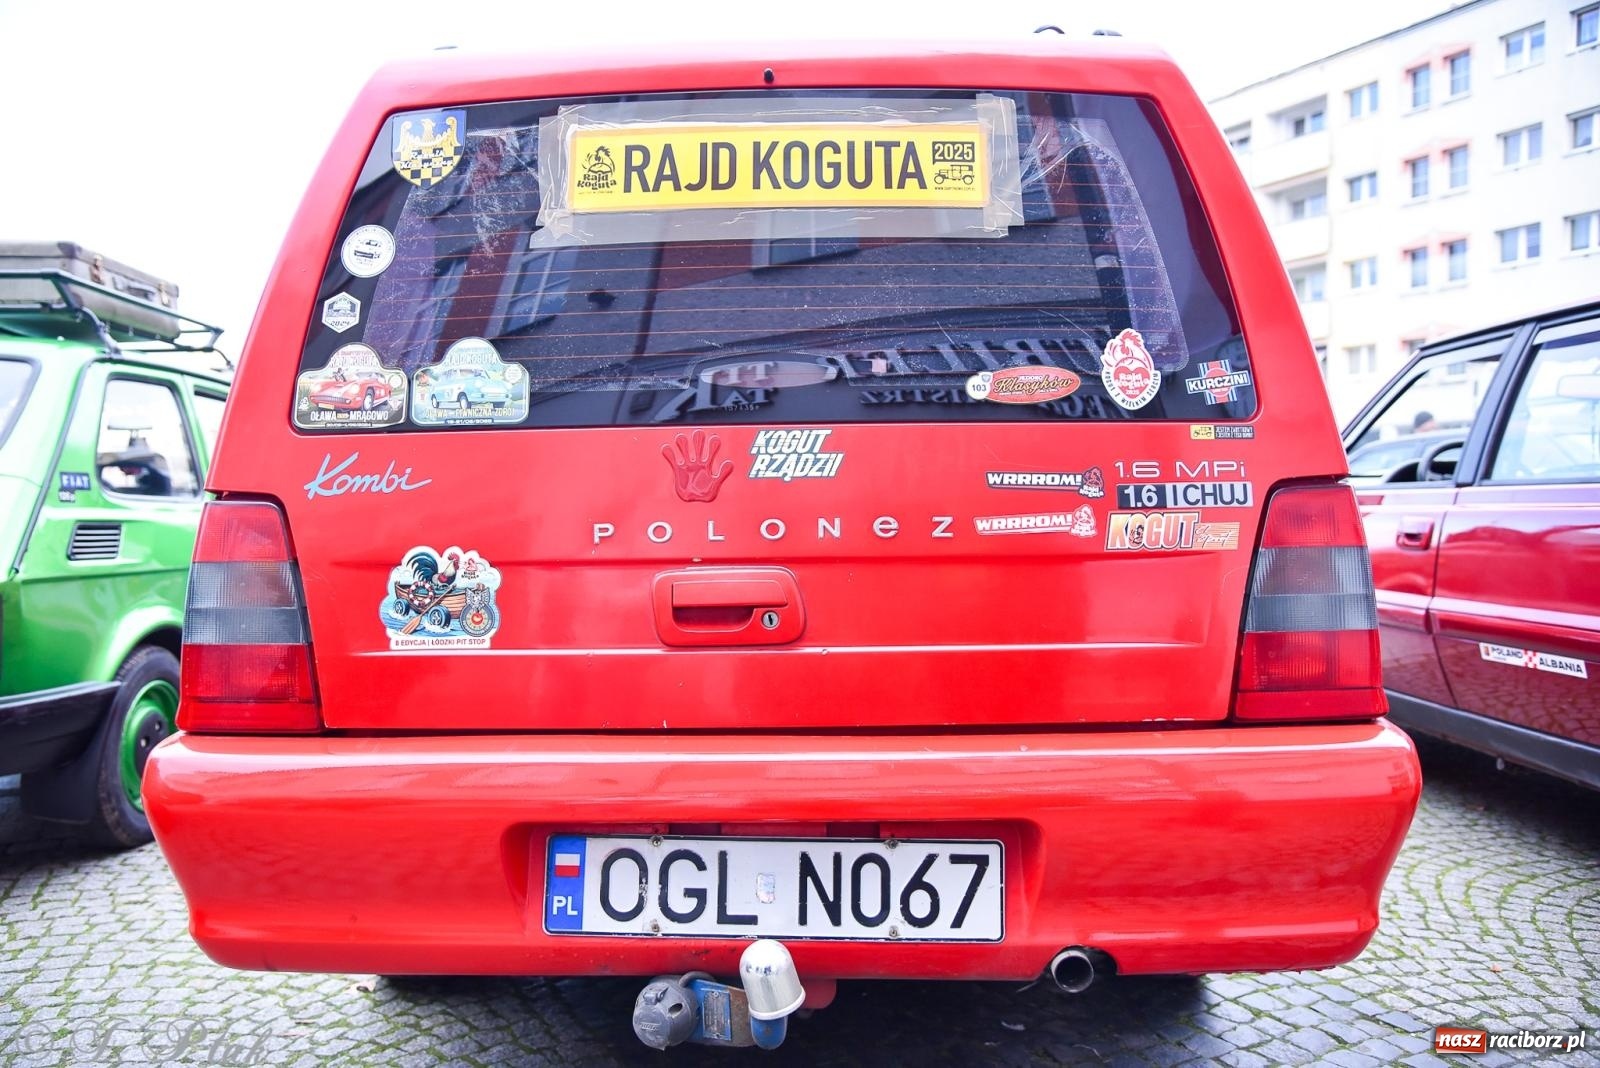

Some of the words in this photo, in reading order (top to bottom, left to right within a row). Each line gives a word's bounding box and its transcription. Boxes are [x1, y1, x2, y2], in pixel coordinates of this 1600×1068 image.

[934, 143, 974, 161] 2025
[623, 141, 737, 194] RAJD
[752, 140, 928, 190] KOGUTA
[583, 173, 609, 182] Rajd
[972, 384, 988, 392] 103
[993, 374, 1074, 396] Klasyków
[1188, 373, 1249, 391] KURCZINI
[311, 411, 337, 421] OŁAWA
[349, 411, 389, 423] MRĄGOWO
[750, 430, 832, 454] KOGUT
[303, 451, 432, 500] Kombi
[1114, 461, 1160, 478] 1.6
[1175, 461, 1245, 478] MPi
[62, 474, 89, 488] FIAT
[987, 473, 1082, 485] WRRROM!
[1124, 485, 1158, 507] 1.6
[1182, 483, 1248, 506] CHUJ
[976, 514, 1072, 530] WRRROM!
[1108, 513, 1199, 549] KOGUT
[431, 638, 455, 646] ŁÓDZKI
[1539, 657, 1583, 673] ALBANIA
[600, 848, 758, 926] OGL
[552, 896, 578, 916] PL
